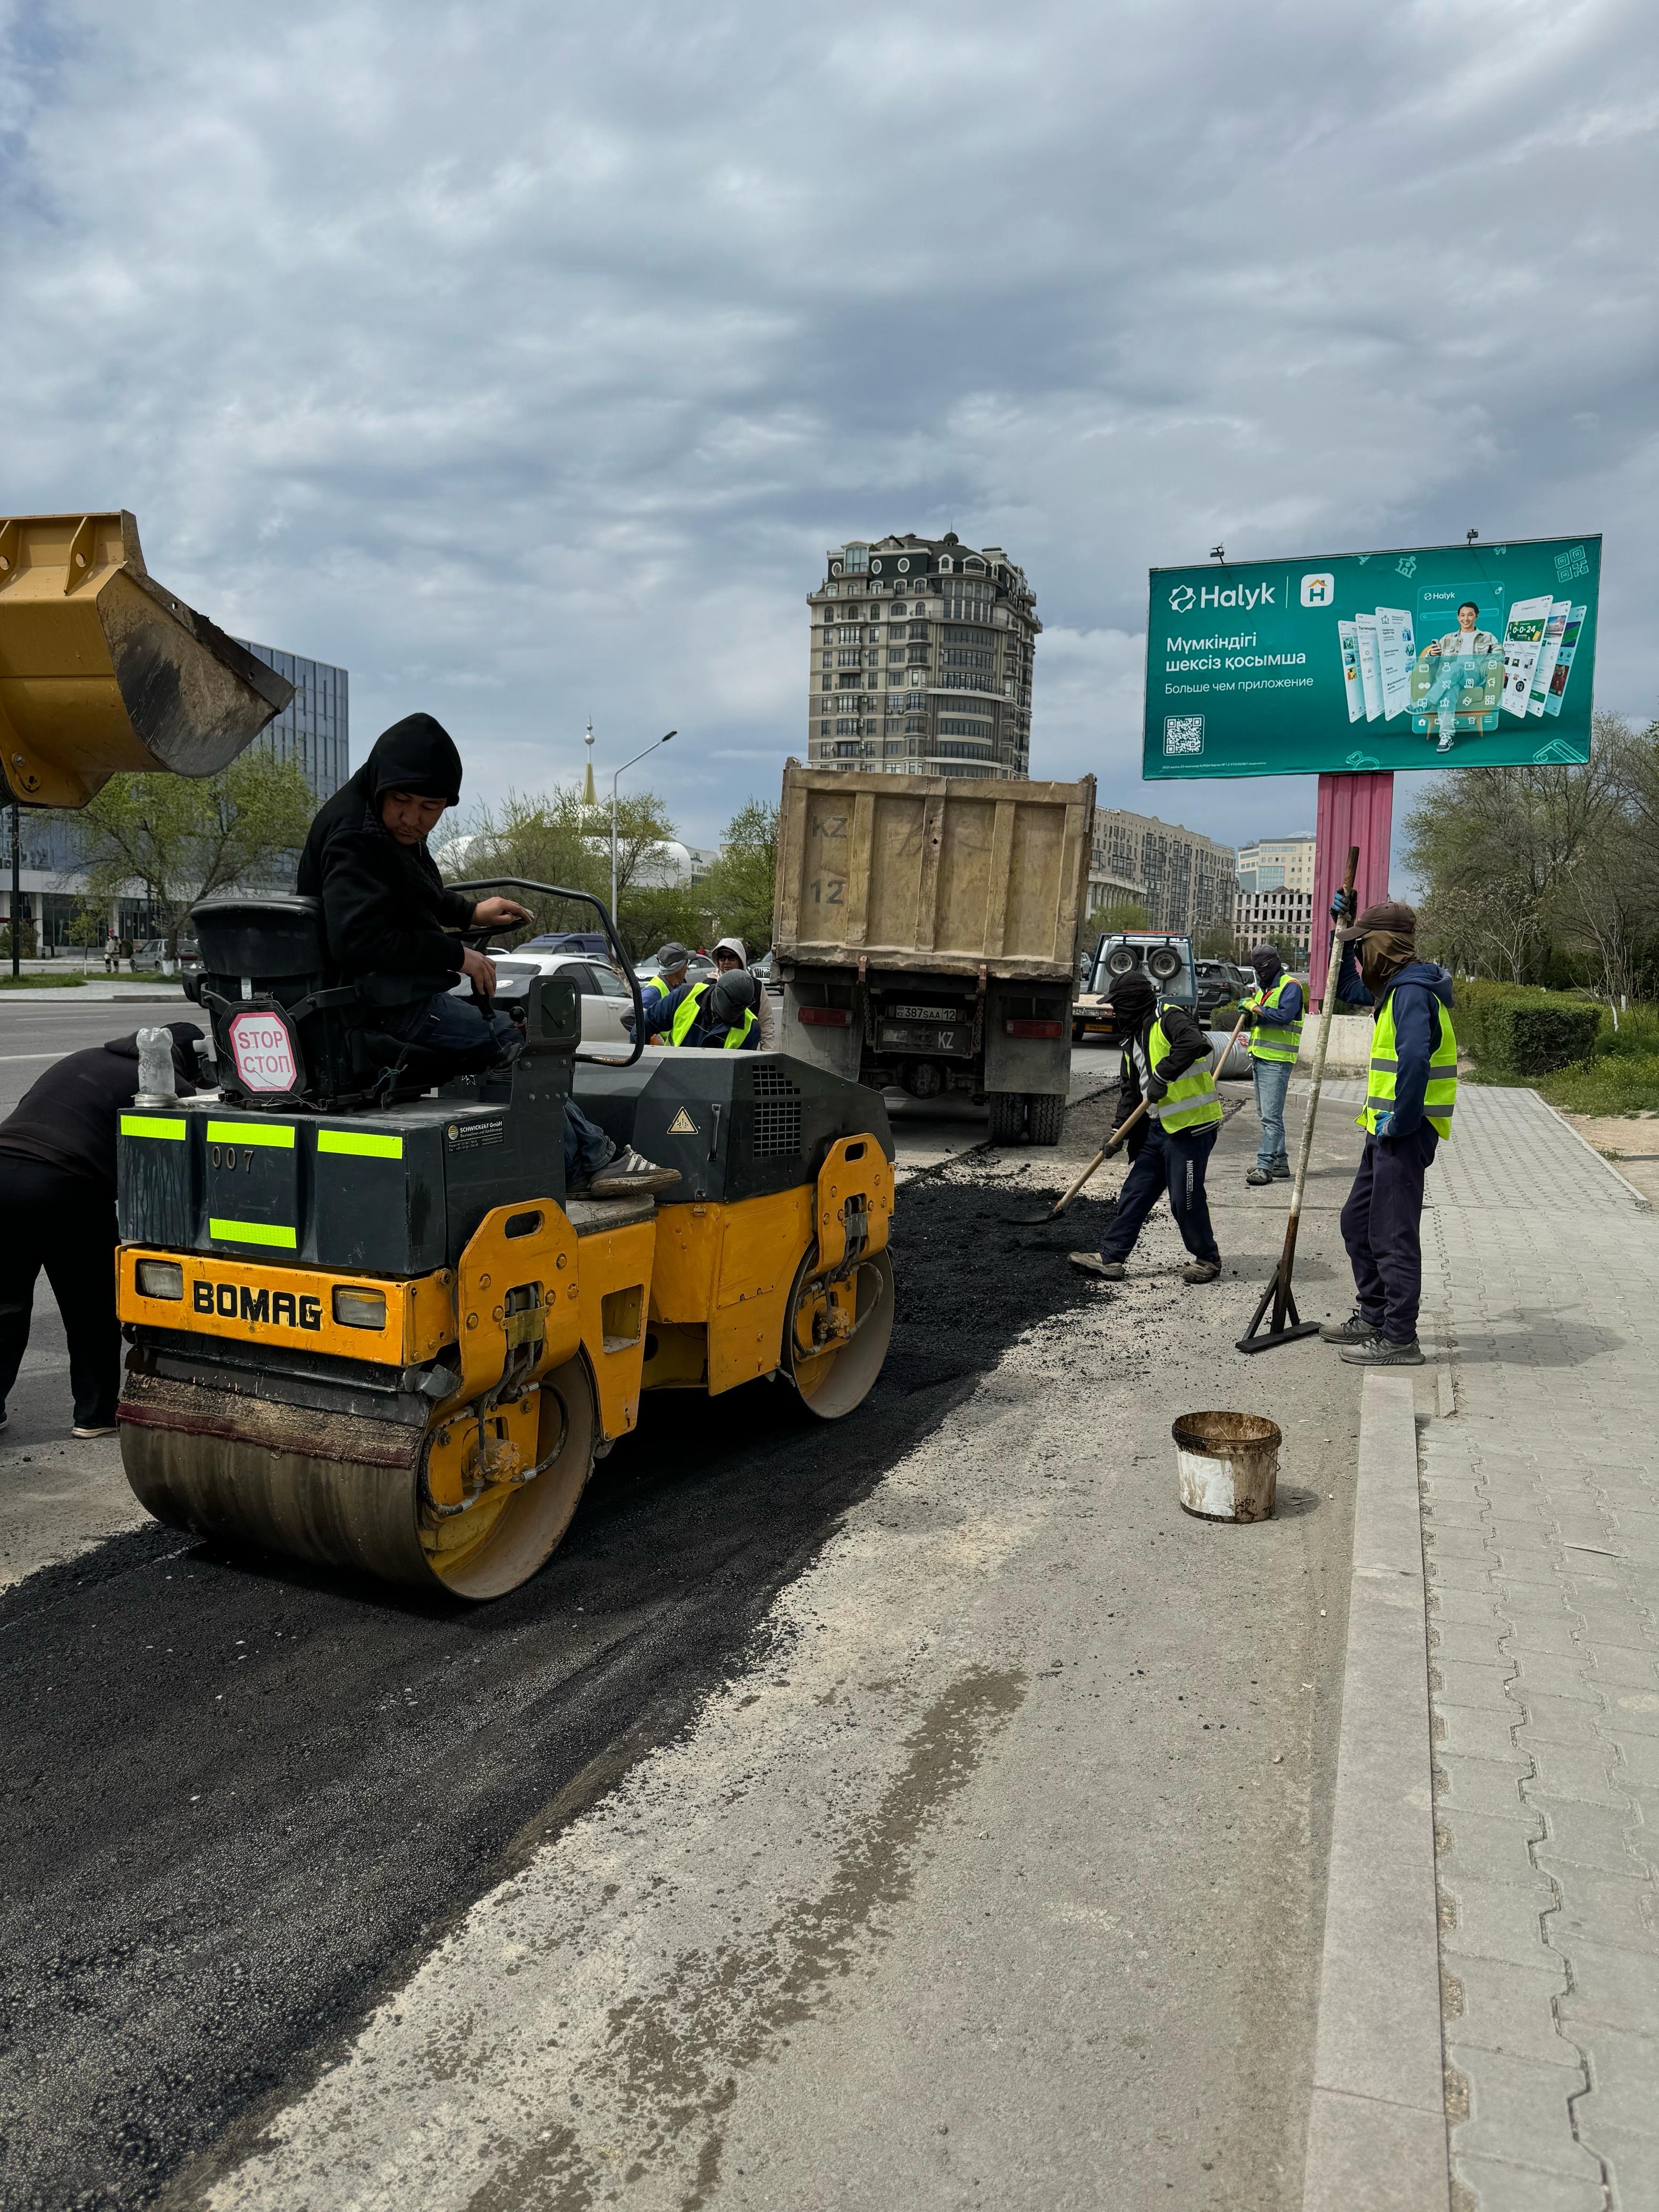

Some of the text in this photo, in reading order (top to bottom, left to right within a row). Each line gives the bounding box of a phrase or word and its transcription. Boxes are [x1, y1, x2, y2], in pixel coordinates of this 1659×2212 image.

[1201, 582, 1276, 610] Halyk
[1432, 591, 1455, 600] Halyk
[1167, 632, 1256, 654] Мүмкіндігі
[1166, 652, 1306, 672] шексіз қосымша
[1165, 677, 1314, 694] Больше чем приложение
[812, 816, 848, 839] KZ
[810, 878, 844, 904] 12
[944, 1010, 956, 1020] 12
[238, 1031, 283, 1049] STOP
[938, 1031, 954, 1049] KZ
[244, 1055, 290, 1074] СТОП
[213, 1146, 255, 1173] 007
[193, 1279, 323, 1331] BOMAG
